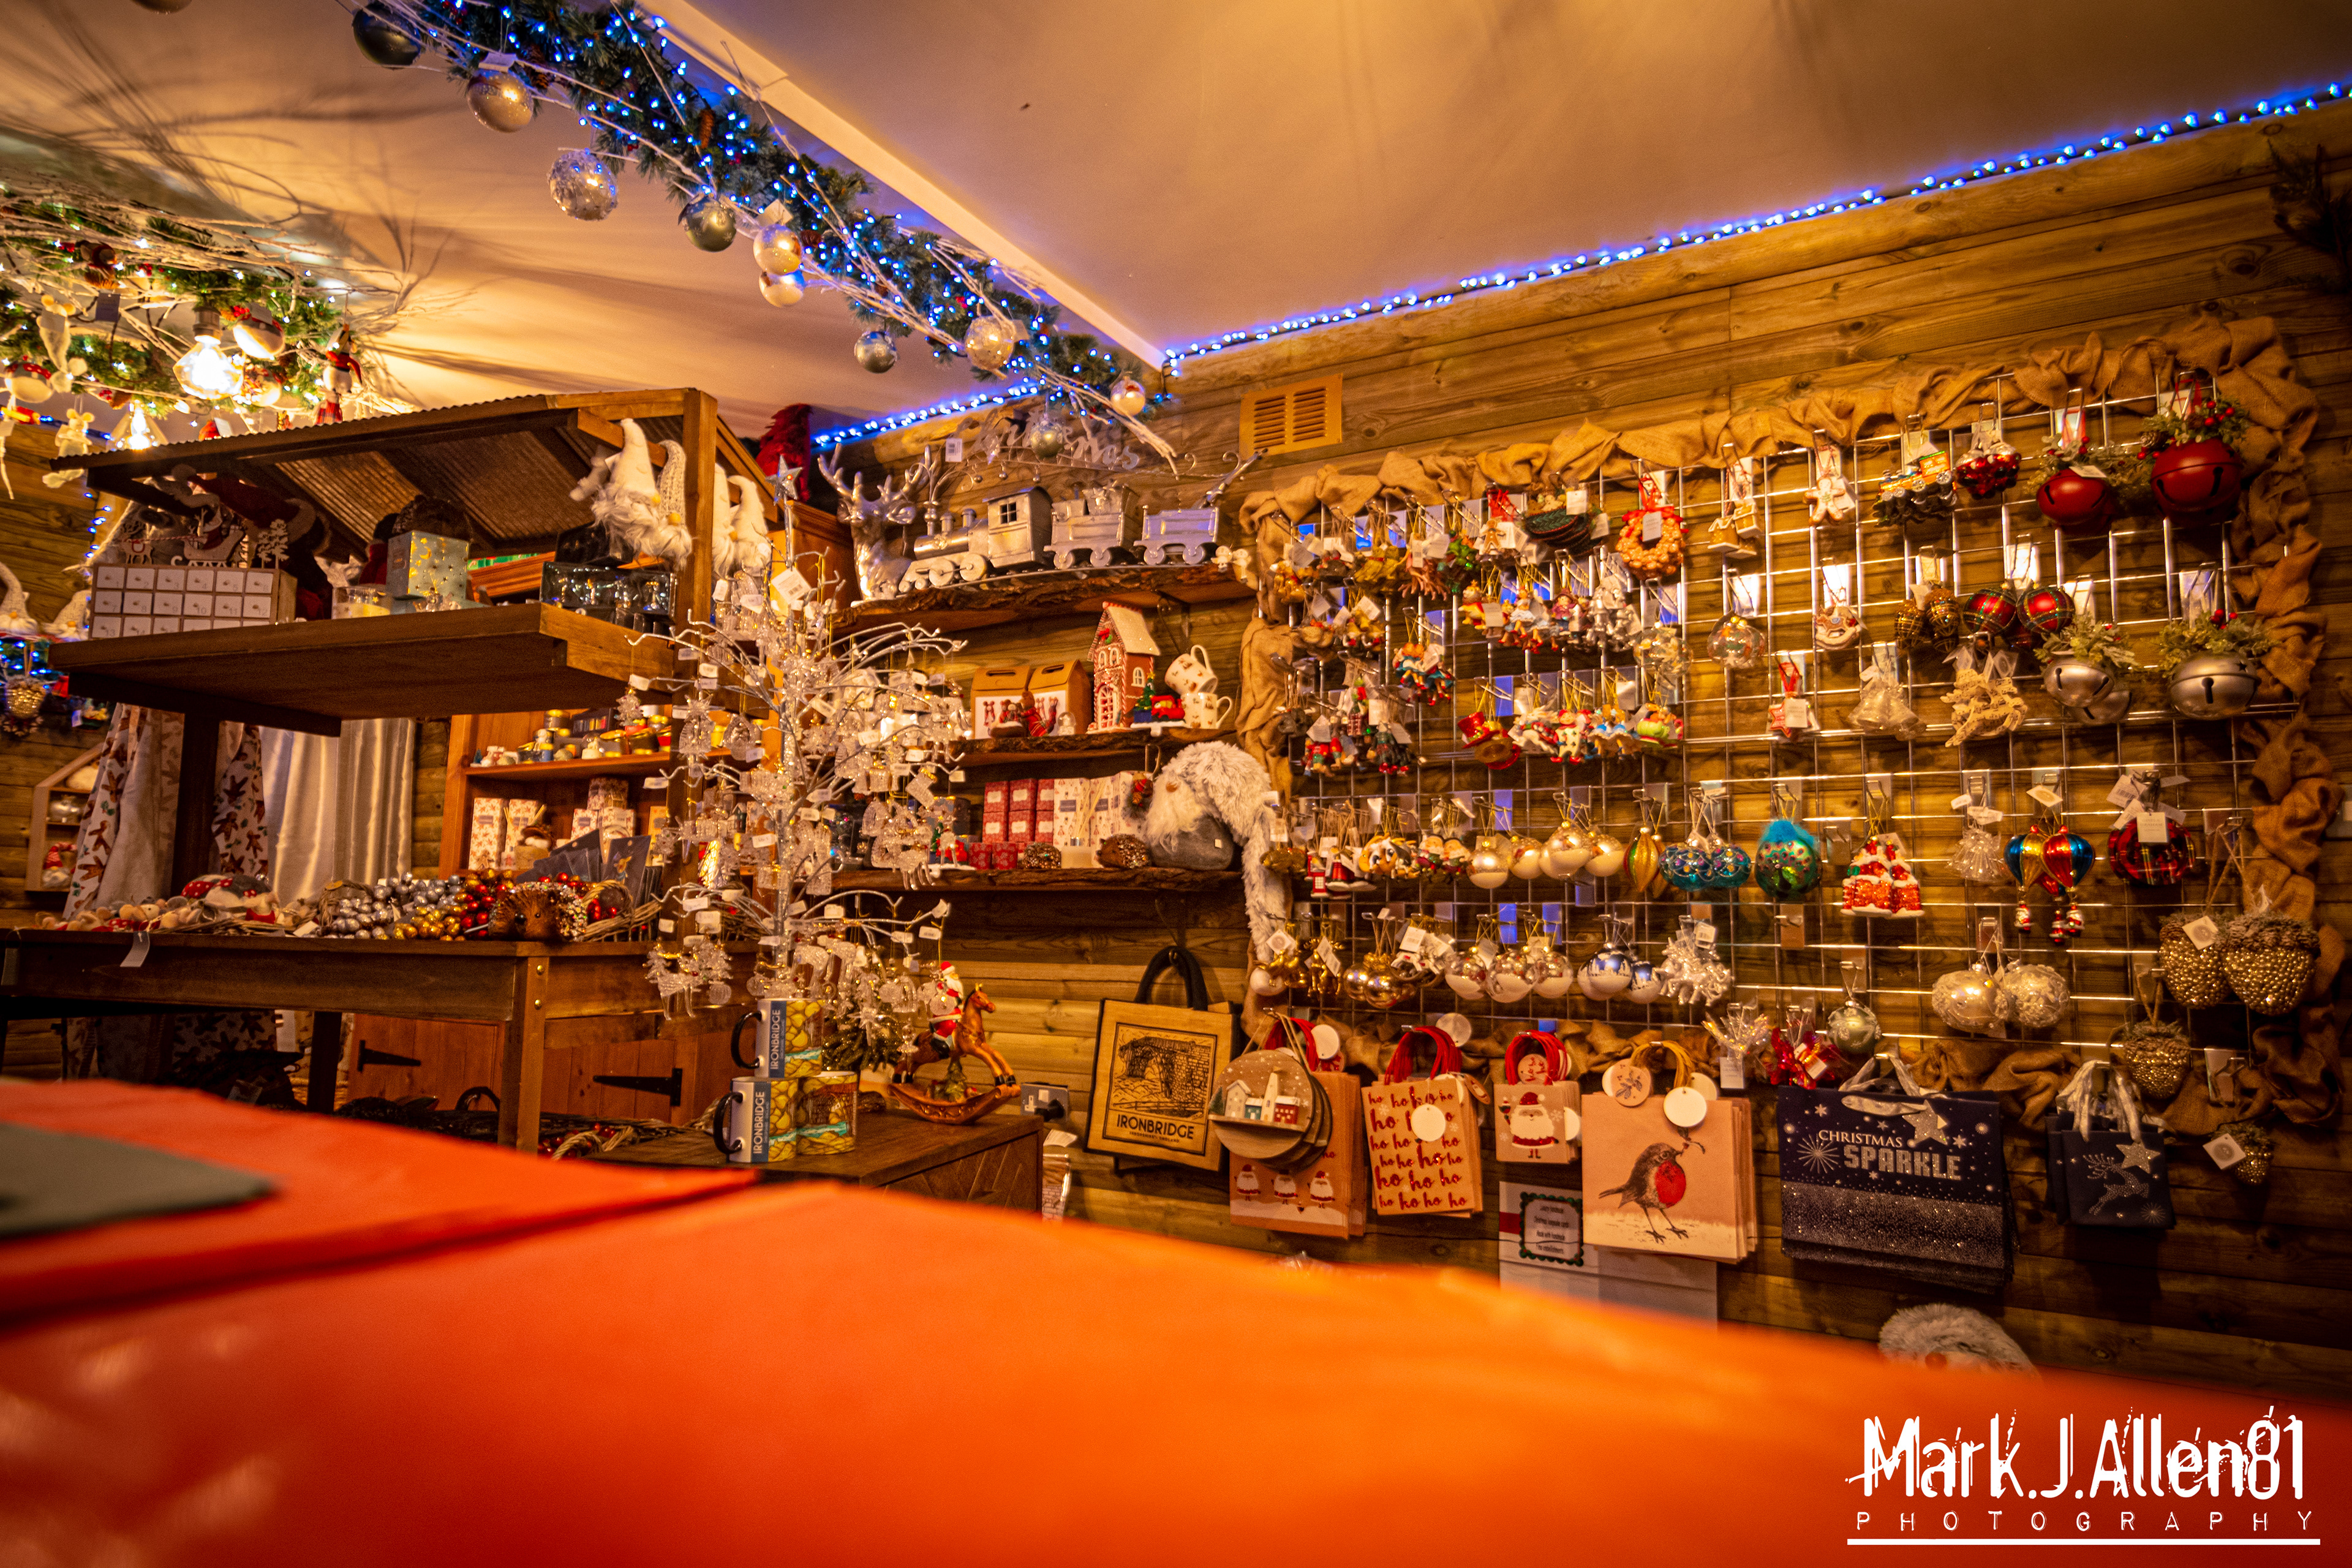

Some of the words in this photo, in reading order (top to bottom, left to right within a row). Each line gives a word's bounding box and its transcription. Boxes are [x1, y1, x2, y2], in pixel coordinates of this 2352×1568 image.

[770, 1009, 781, 1070] IRONBRIDGE
[1368, 1092, 1384, 1104] ho
[1390, 1093, 1409, 1107] ho
[1439, 1090, 1453, 1101] ho
[753, 1091, 765, 1155] IRONBRIDGE
[1117, 1114, 1194, 1140] IRONBRIDGE
[1370, 1109, 1398, 1132] ho
[1370, 1136, 1389, 1151] ho
[1392, 1133, 1411, 1150] ho
[1441, 1135, 1460, 1149] ho
[1819, 1129, 1903, 1148] CHRISTMAS
[1379, 1155, 1395, 1167] ho
[1396, 1153, 1414, 1169] ho
[1416, 1144, 1446, 1169] ho
[1447, 1152, 1463, 1165] ho
[1843, 1144, 1961, 1181] SPARKLE
[1374, 1165, 1403, 1189] ho
[1409, 1170, 1434, 1191] ho
[1439, 1167, 1462, 1186] ho
[1379, 1195, 1394, 1208] ho
[1398, 1192, 1420, 1210] ho
[1423, 1192, 1442, 1208] ho
[1448, 1192, 1468, 1208] ho
